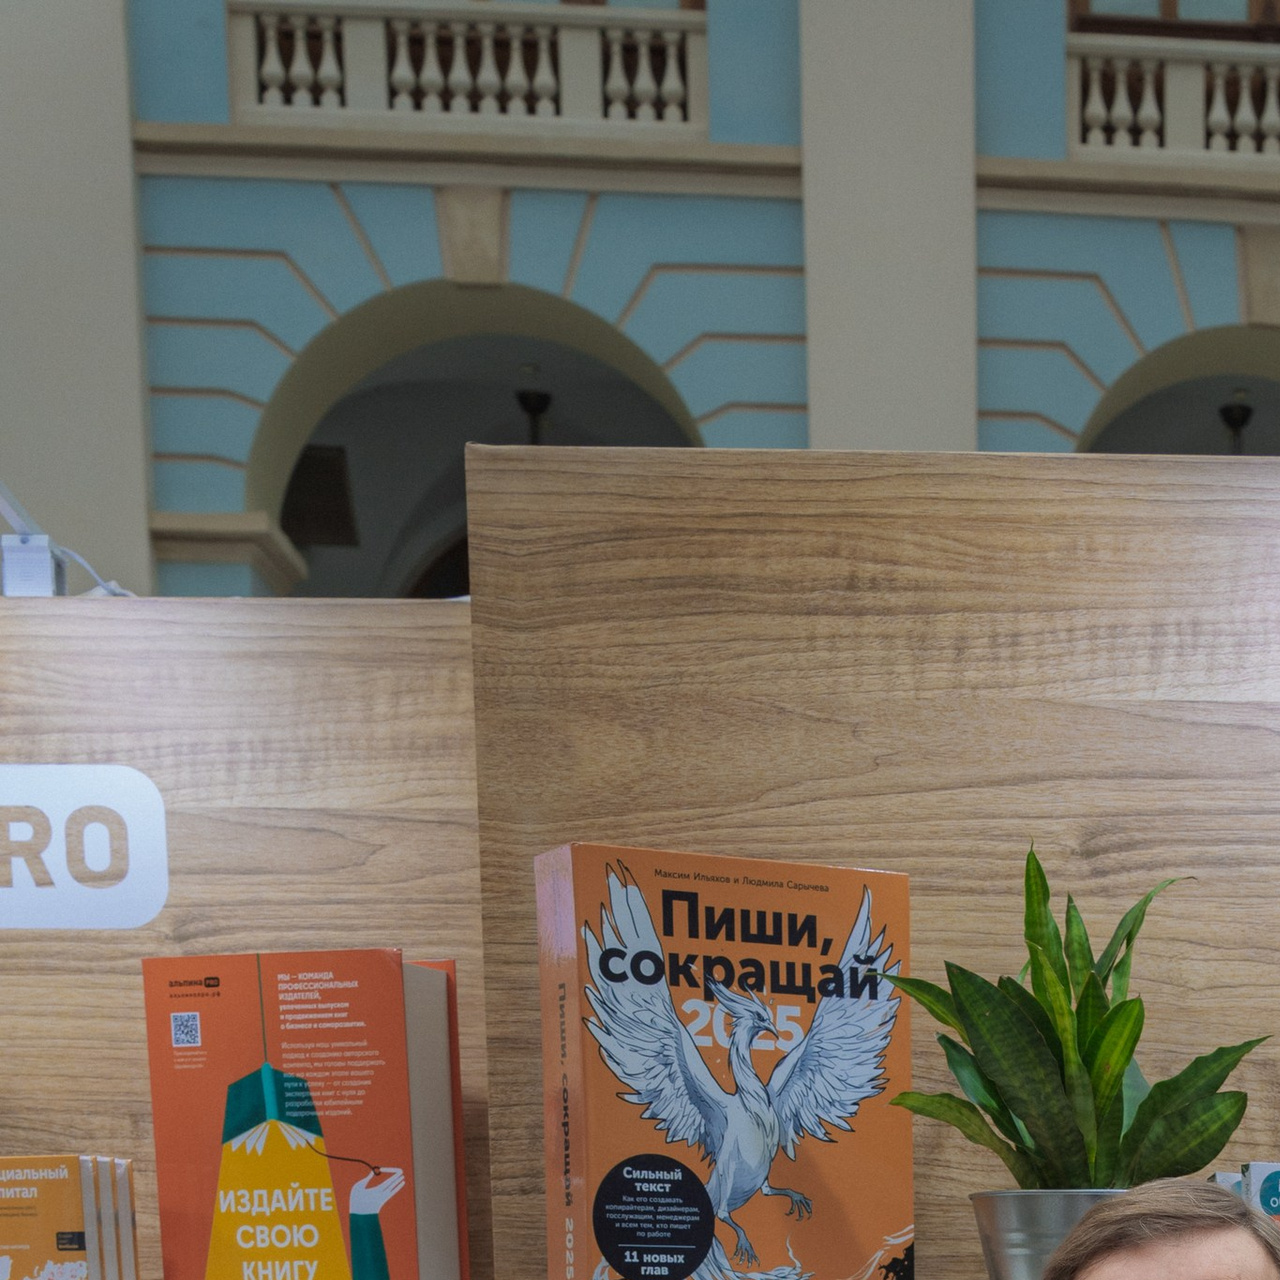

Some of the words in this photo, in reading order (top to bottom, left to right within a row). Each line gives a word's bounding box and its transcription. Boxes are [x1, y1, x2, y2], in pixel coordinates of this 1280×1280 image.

[654, 868, 690, 880] Максим
[693, 872, 731, 884] Ильяхов
[742, 876, 784, 889] Людмила
[786, 881, 830, 893] Сарычева
[661, 888, 834, 956] Пиши,
[599, 946, 879, 1004] сокращай
[622, 1166, 683, 1181] Сильный
[218, 1181, 334, 1217] ИЗДАЙТЕ
[634, 1182, 672, 1193] текст
[235, 1223, 320, 1249] СВОЮ
[624, 1250, 639, 1263] 11
[643, 1253, 685, 1264] новых
[640, 1265, 670, 1276] глав
